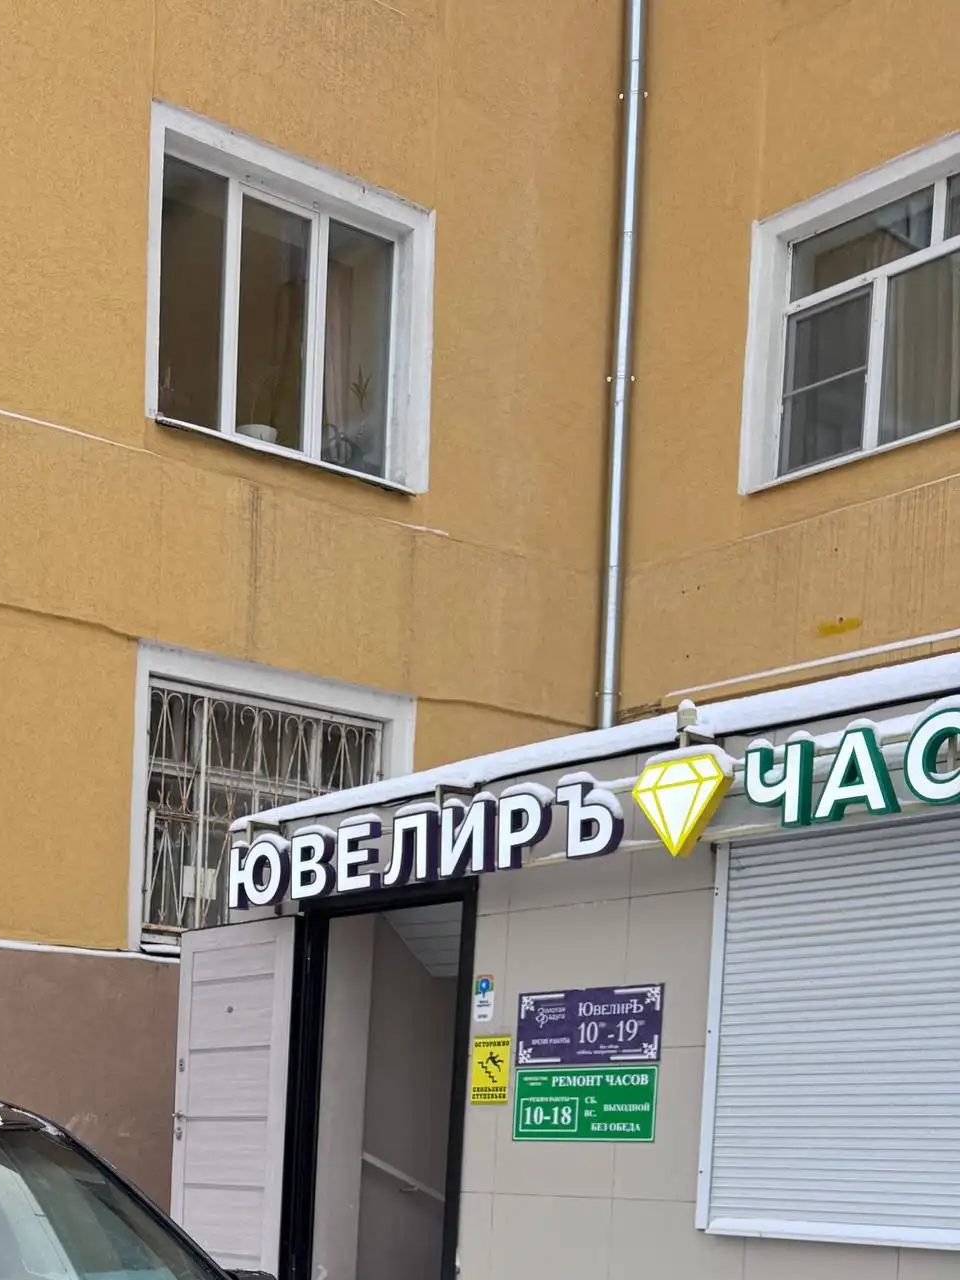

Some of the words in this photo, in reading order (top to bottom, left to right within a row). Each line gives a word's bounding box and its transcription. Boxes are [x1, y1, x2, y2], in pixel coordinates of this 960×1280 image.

[228, 781, 623, 910] ЮВЕЛИРЪ
[474, 1040, 510, 1048] ОСТОРОЖНО
[551, 1075, 603, 1087] РЕМОНТ
[605, 1074, 649, 1086] ЧАСОВ
[603, 1102, 650, 1112] ВЫХОДНОЙ
[524, 1106, 572, 1125] 10-18
[591, 1122, 608, 1132] БЕЗ
[609, 1122, 641, 1132] ОБЕДА
